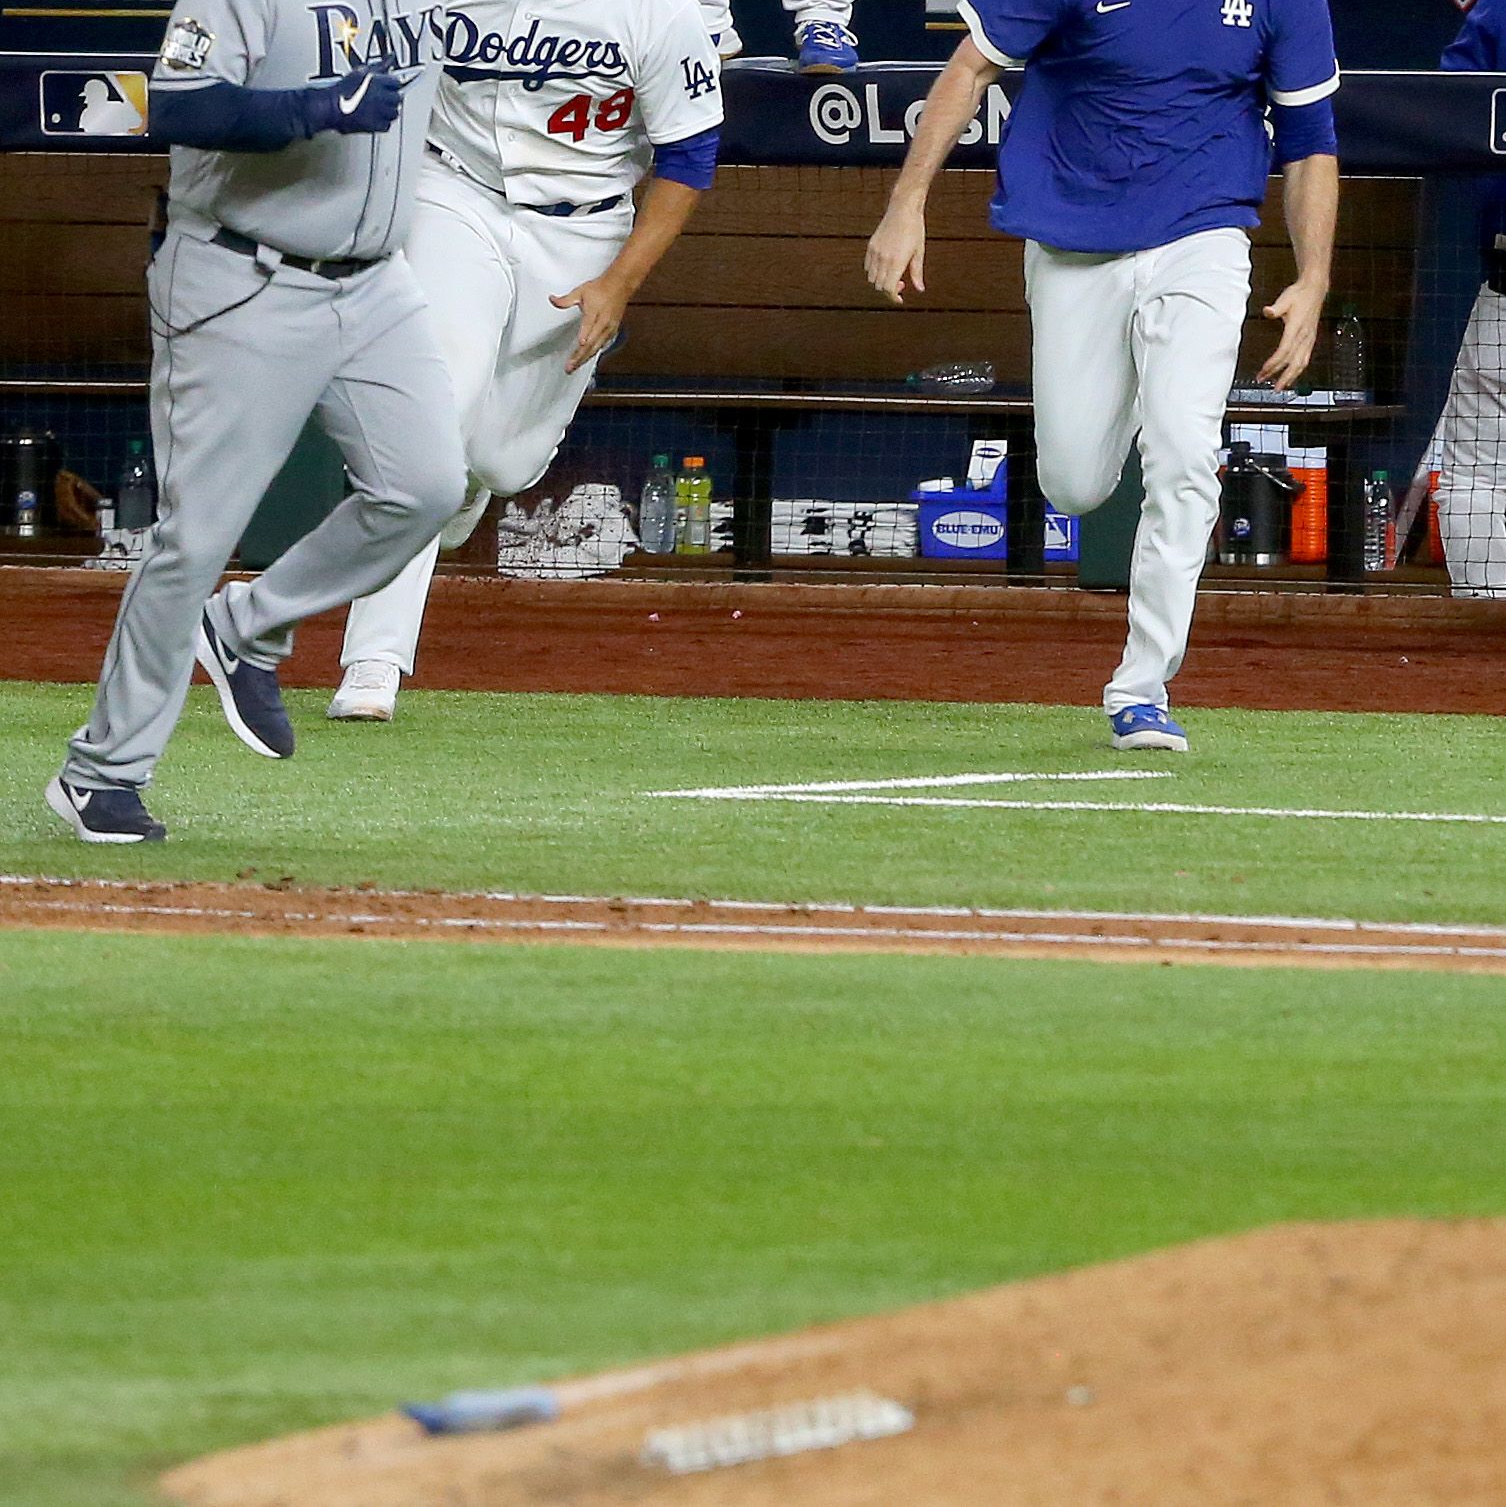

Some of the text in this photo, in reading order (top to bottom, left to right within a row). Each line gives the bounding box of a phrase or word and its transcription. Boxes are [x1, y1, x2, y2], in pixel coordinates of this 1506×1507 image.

[445, 10, 628, 92] Dodgers
[680, 55, 717, 101] LA
[546, 86, 635, 143] 48
